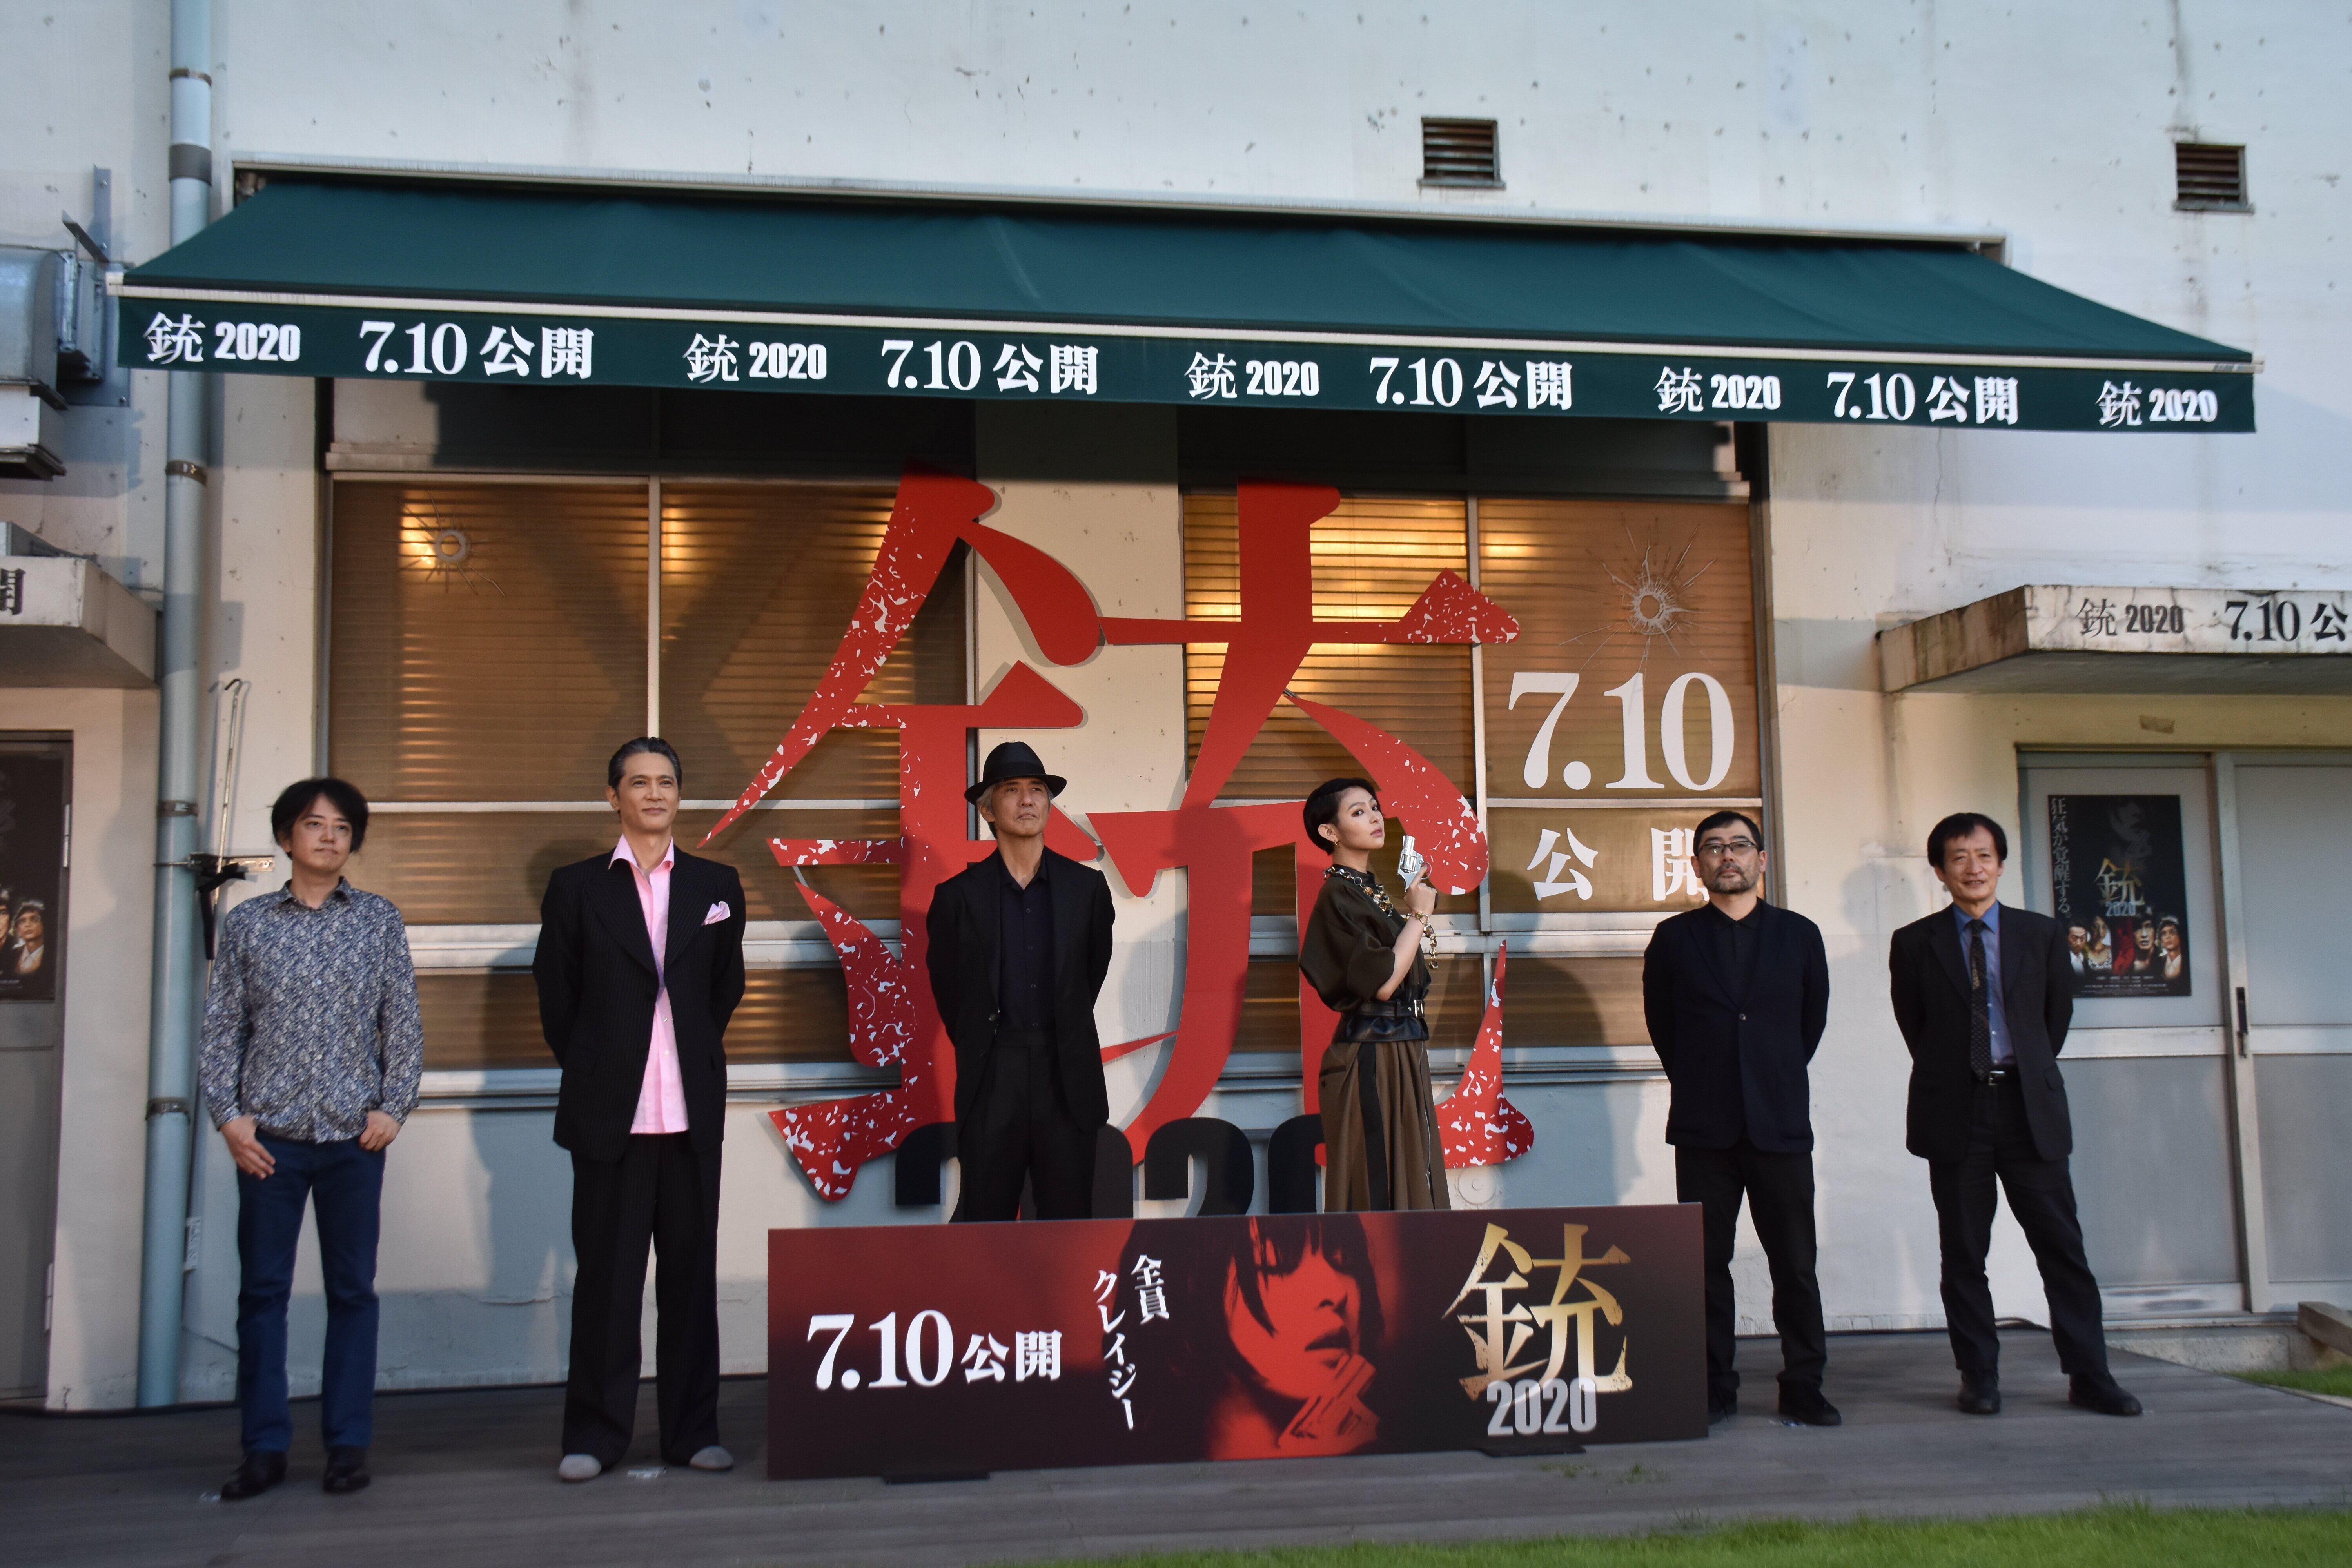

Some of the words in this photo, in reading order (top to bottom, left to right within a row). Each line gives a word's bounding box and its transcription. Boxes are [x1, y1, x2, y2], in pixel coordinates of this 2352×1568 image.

[142, 311, 205, 364] 銃
[215, 322, 301, 361] 2020
[359, 321, 468, 374] 7.10
[479, 326, 594, 379] 公開
[683, 333, 740, 383] 銃
[749, 342, 827, 380] 2020
[881, 339, 981, 391] 7.10
[993, 343, 1099, 395] 公開
[1184, 352, 1238, 400] 銃
[1246, 360, 1319, 396] 2020
[1369, 357, 1463, 407] 7.10
[1473, 360, 1572, 410] 公開
[1653, 366, 1704, 414] 銃
[1710, 374, 1781, 410] 2020
[1827, 372, 1915, 421] 7.10
[1925, 376, 2018, 425] 公開
[2095, 380, 2143, 428] 銃
[2149, 388, 2218, 422] 2020
[2076, 598, 2118, 638] 銃
[2125, 605, 2184, 633] 2020
[2225, 601, 2300, 641] 7.10
[2310, 603, 2348, 642] 公
[1508, 672, 1734, 791] 7.10
[2094, 858, 2145, 906] 銃
[2105, 901, 2137, 916] 2020
[1132, 1255, 1169, 1324] 全員
[1441, 1223, 1632, 1400] 銃
[1093, 1270, 1136, 1430] クレイジー
[1487, 1377, 1598, 1436] 2020
